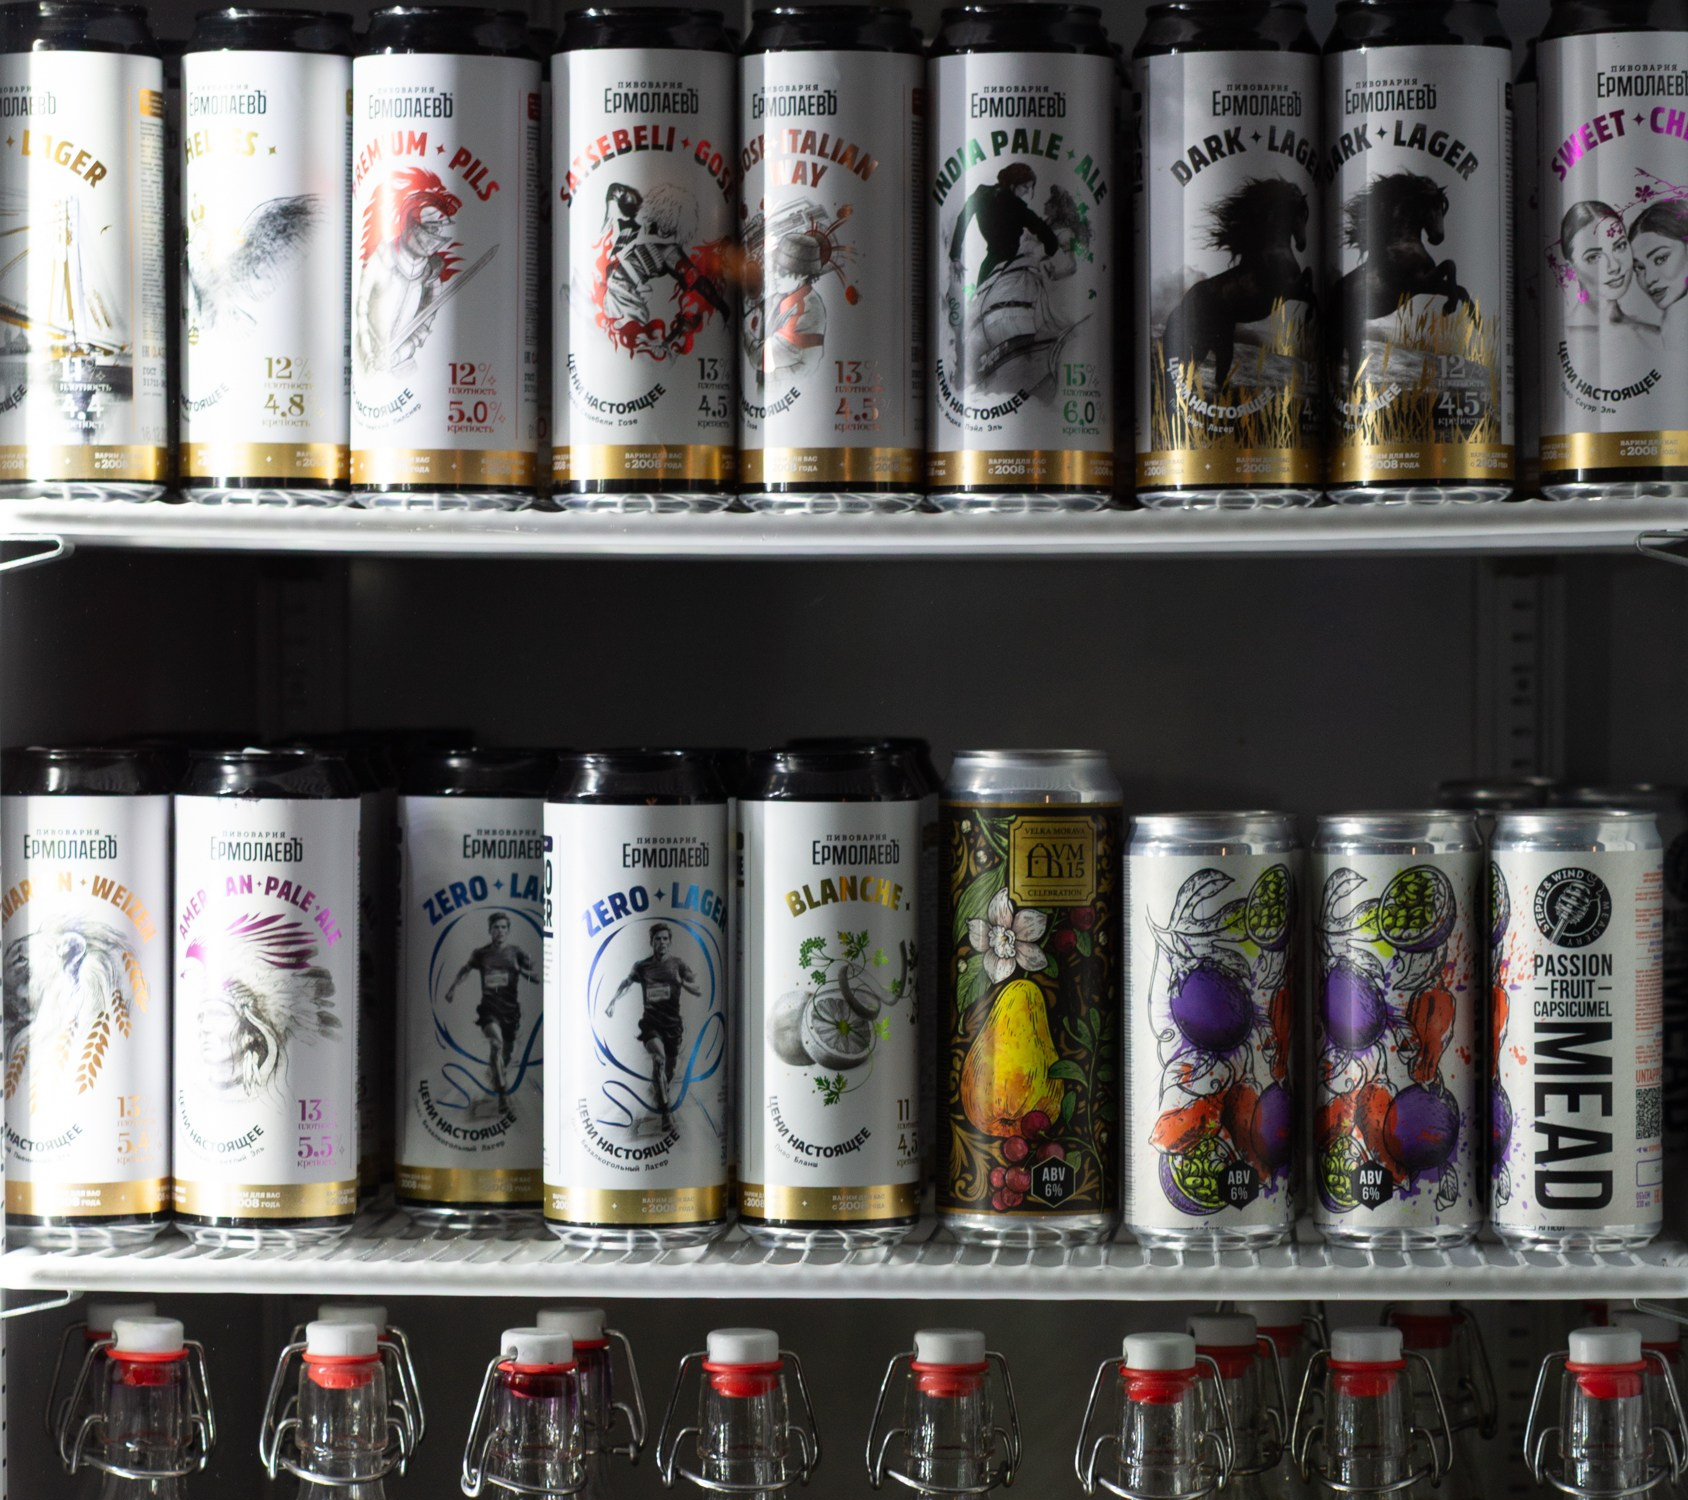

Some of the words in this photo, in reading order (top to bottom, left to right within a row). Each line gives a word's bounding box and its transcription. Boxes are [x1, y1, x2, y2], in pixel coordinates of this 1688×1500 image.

[1611, 64, 1677, 73] ПИВОВАРНЯ
[617, 81, 683, 89] ПИВОВАРНЯ
[983, 85, 1050, 94] ПИВОВАРНЯ
[1226, 83, 1289, 92] ПИВОВАРНЯ
[1356, 78, 1417, 89] ПИВОВАРНЯ
[604, 87, 699, 114] ЕРМОЛАЕВЪ
[970, 91, 1066, 119] ЕРМОЛАЕВЪ
[184, 128, 259, 167] HELES
[780, 128, 879, 183] ITALIAN
[1170, 125, 1248, 188] DARK
[1394, 120, 1479, 181] LAGER
[1552, 108, 1626, 182] SWEET
[352, 131, 428, 199] PREMUM
[448, 146, 501, 202] PILS
[560, 125, 676, 208] SATSEBELI
[931, 138, 988, 208] INDIA
[990, 128, 1063, 162] PALE
[1074, 154, 1109, 206] ALE
[1559, 341, 1578, 386] ЦЕНИ
[1577, 369, 1662, 401] НАСТОЯЩЕЕ
[583, 383, 666, 415] НАСТОЯЩЕЕ
[936, 358, 952, 404] ЦЕНИ
[948, 387, 1030, 421] НАСТОЯЩЕЕ
[1188, 386, 1275, 419] НАСТОЯЩЕЕ
[632, 459, 662, 470] 2008
[1627, 446, 1658, 456] 2008
[995, 464, 1026, 475] 2008
[463, 834, 544, 860] ЕРМОЛАЕВ
[812, 839, 900, 866] ЕРМОЛАЕВЪ
[1067, 862, 1085, 878] 15
[422, 875, 489, 925] ZERO
[784, 875, 904, 919] BLANCHE
[1027, 889, 1082, 897] CELEBRATION
[1535, 891, 1550, 933] STEPPE
[1551, 869, 1585, 882] WIND
[179, 874, 253, 940] AMERAN
[265, 876, 316, 913] PALE
[314, 907, 343, 947] ALE
[582, 886, 650, 938] ZERO
[671, 881, 729, 934] LAGER
[1534, 954, 1612, 976] PASSION
[1550, 980, 1596, 999] FRUIT
[1534, 1001, 1612, 1017] CAPSICUMEL
[419, 1079, 438, 1121] ЦЕНИ
[437, 1113, 517, 1142] НАСТОЯЩЕЕ
[1534, 1022, 1613, 1209] MEAD
[767, 1095, 788, 1138] ЦЕНИ
[787, 1126, 872, 1159] НАСТОЯЩЕЕ
[597, 1130, 681, 1160] НАСТОЯЩЕЕ
[644, 1160, 669, 1172] Лагер
[1042, 1166, 1066, 1182] ABV
[1227, 1170, 1251, 1186] ABV
[1359, 1170, 1383, 1185] ABV
[1045, 1183, 1063, 1197] 6%
[1231, 1186, 1249, 1201] 6%
[1362, 1186, 1380, 1201] 6%
